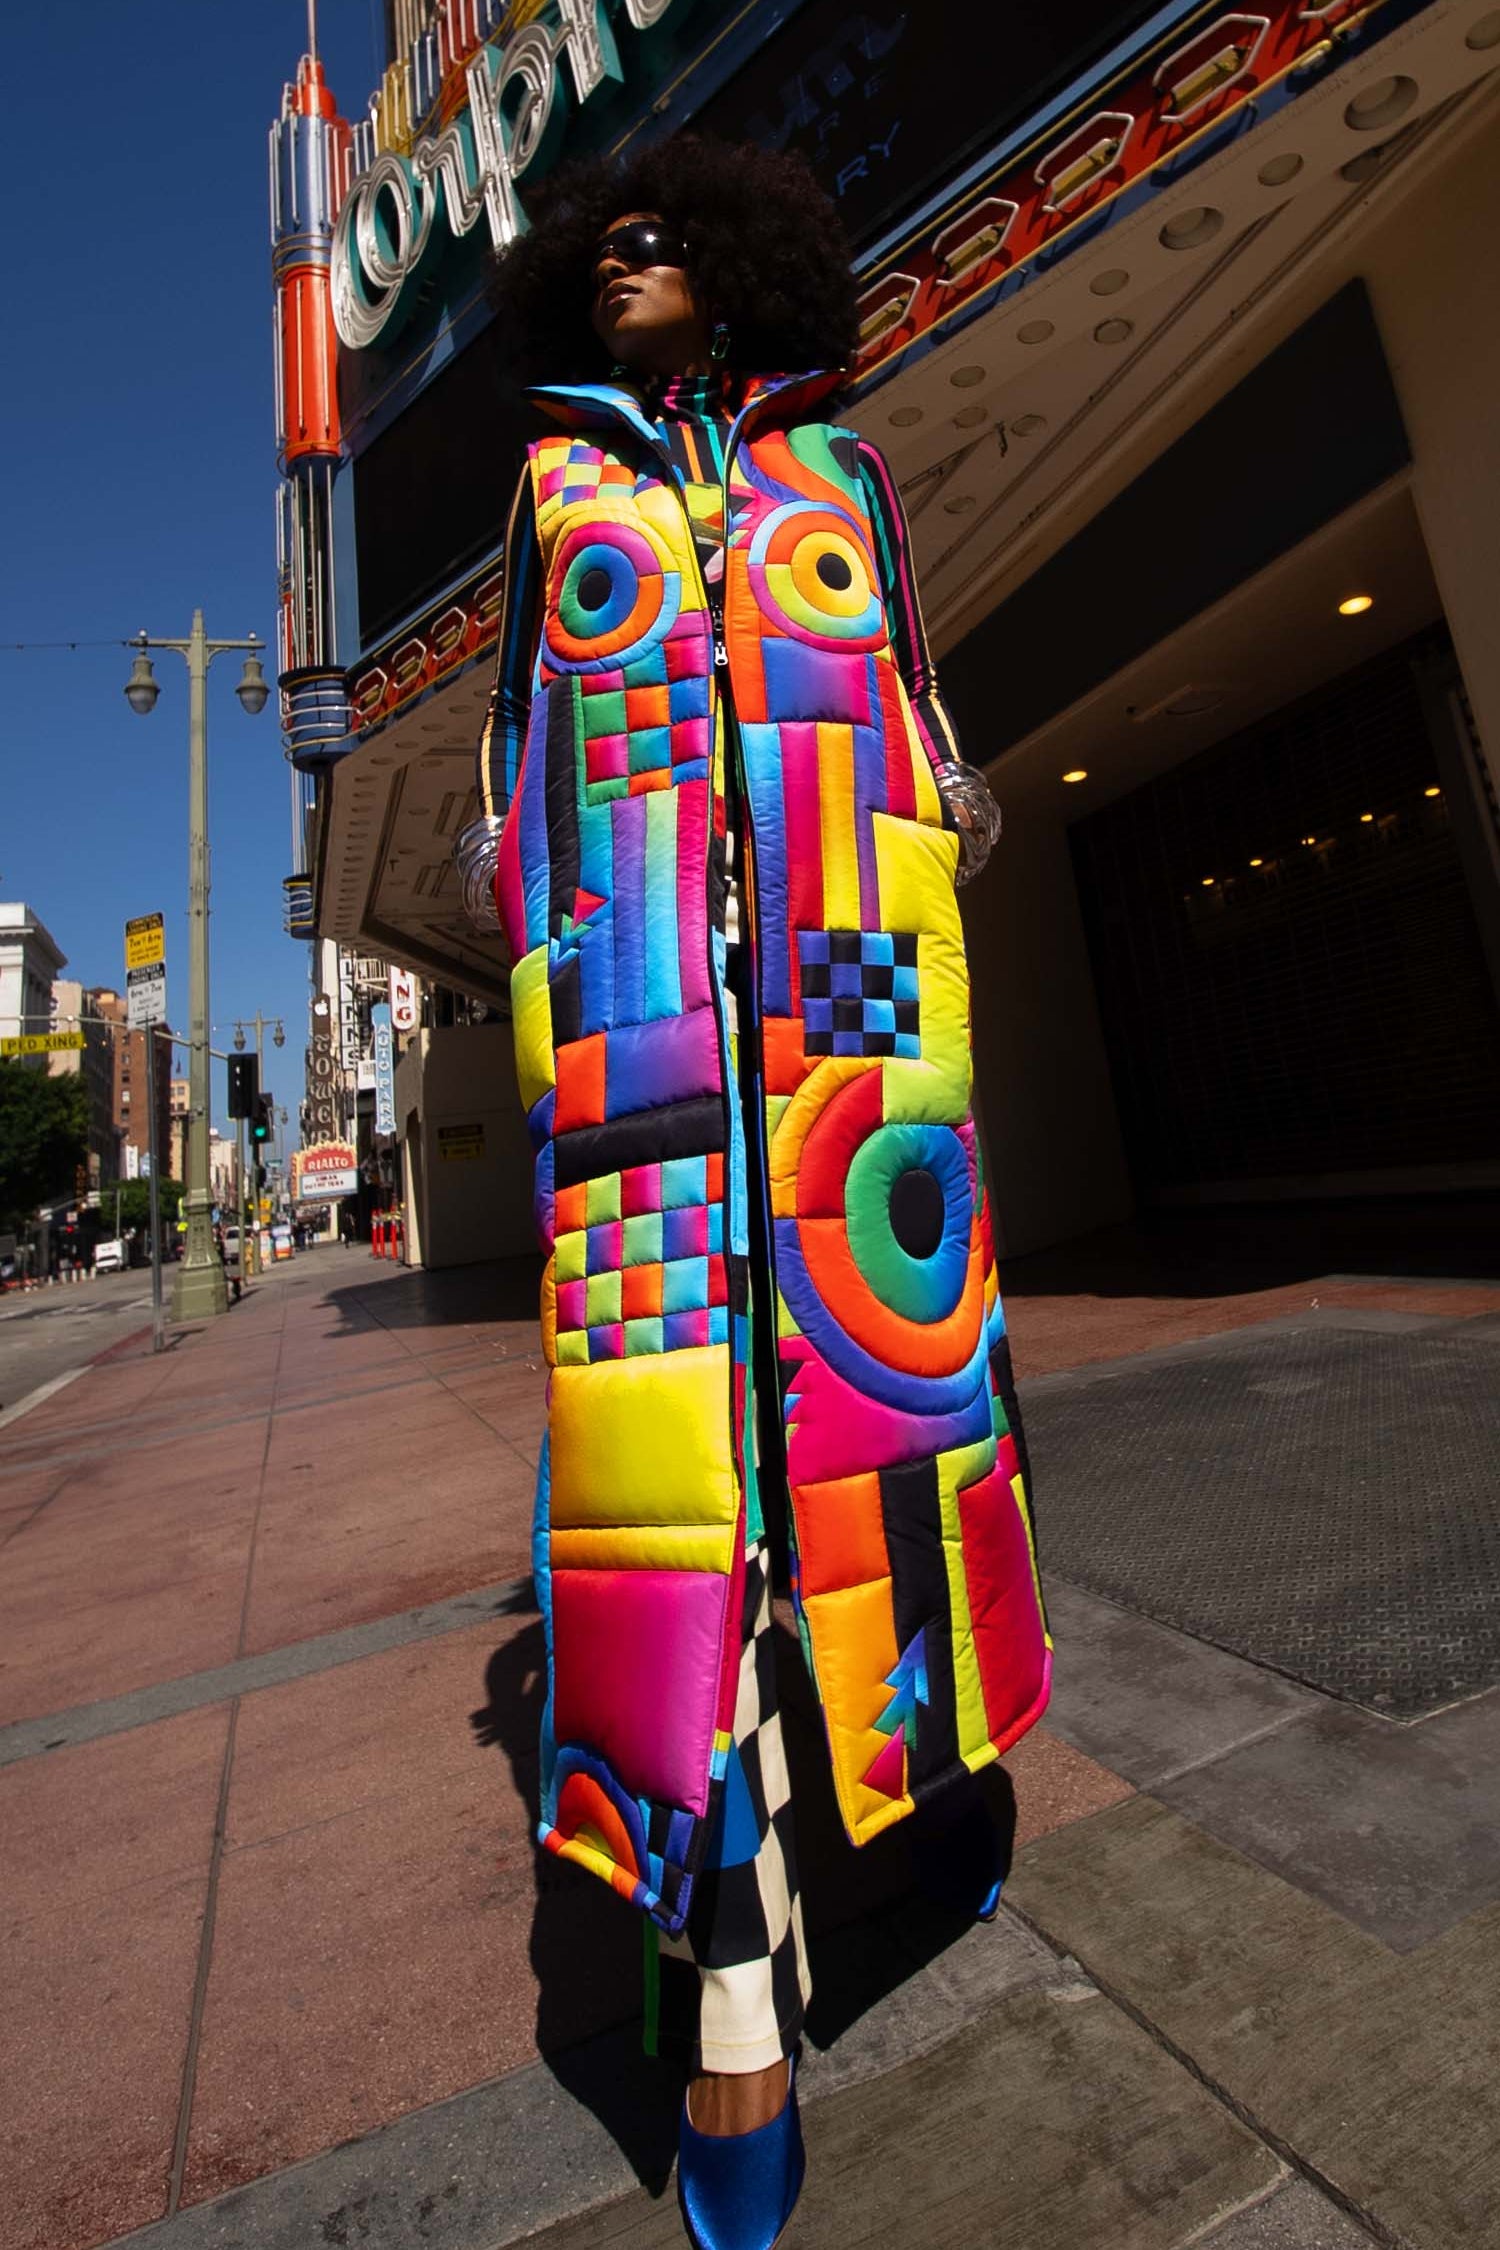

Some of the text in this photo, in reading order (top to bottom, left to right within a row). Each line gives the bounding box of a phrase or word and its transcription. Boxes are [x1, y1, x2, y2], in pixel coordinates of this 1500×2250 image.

[7, 1033, 78, 1051] PED XING
[308, 1156, 349, 1171] RIALTO
